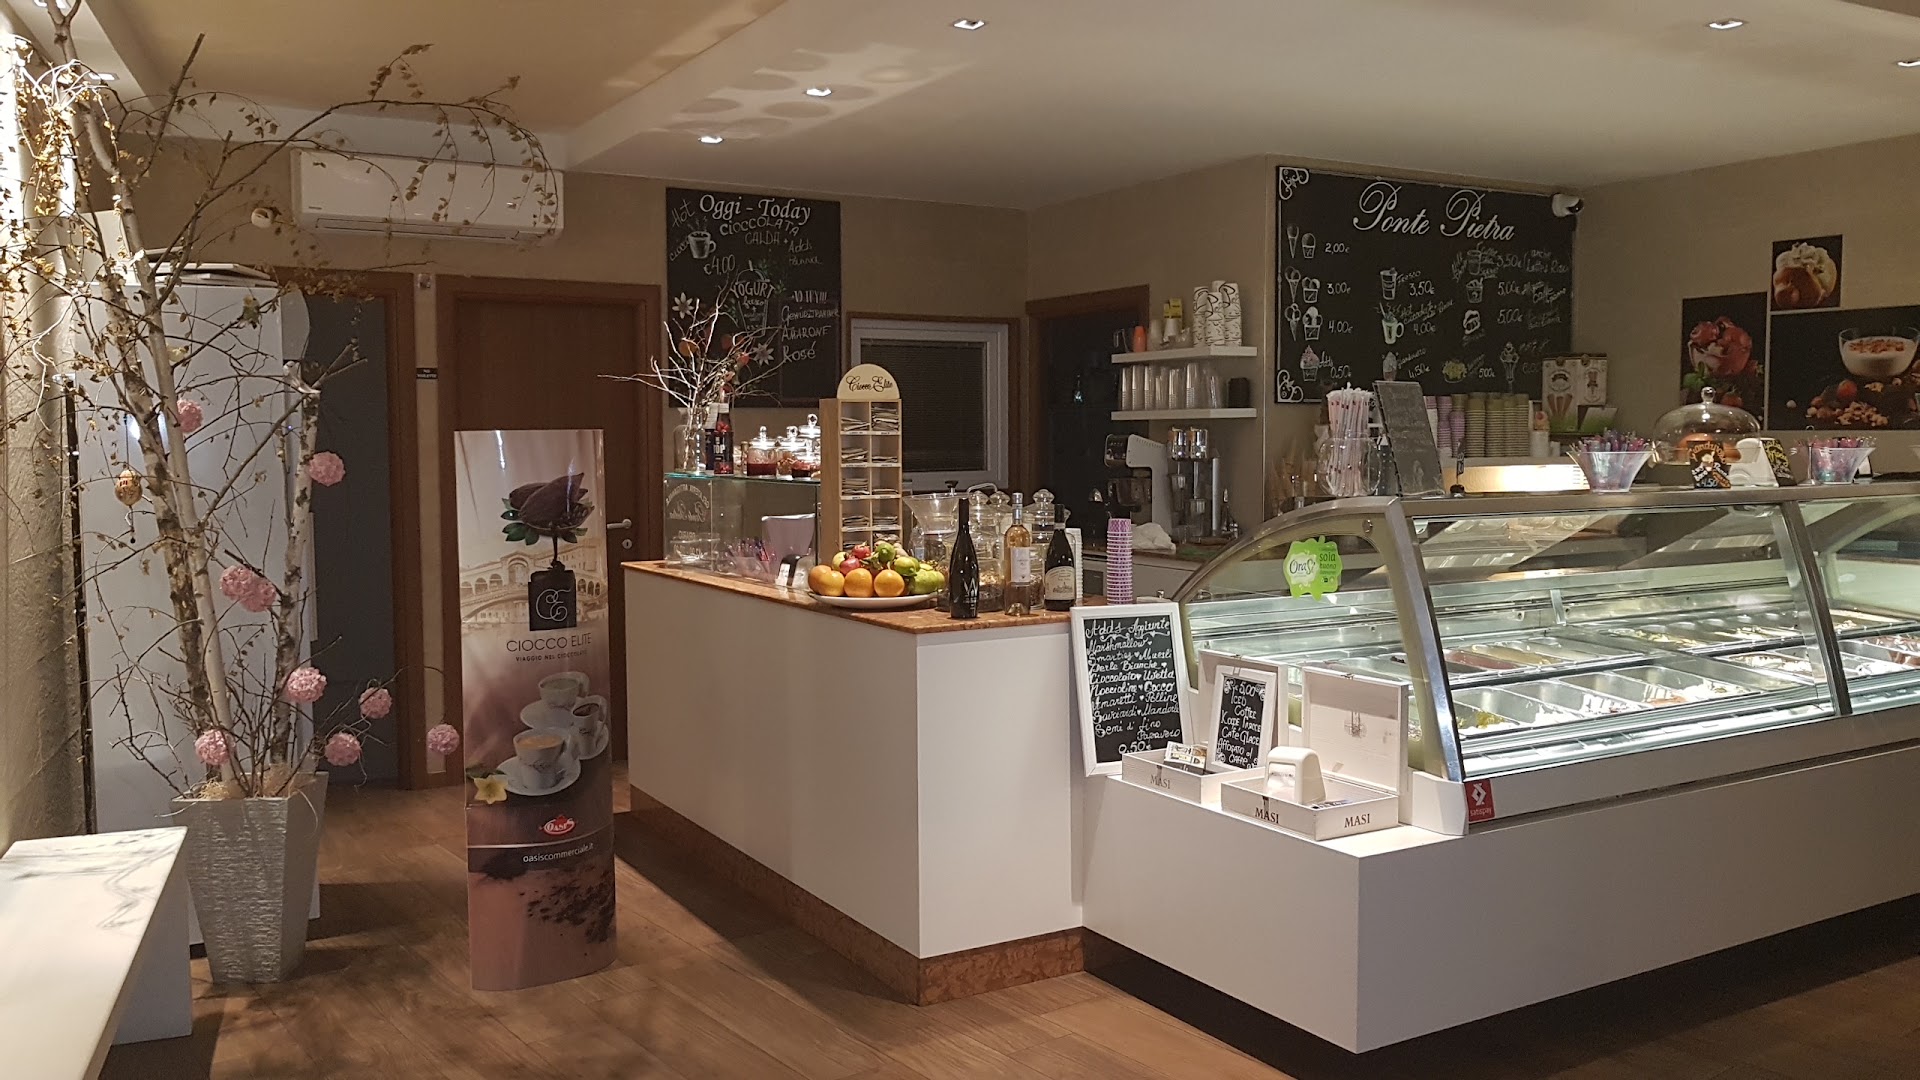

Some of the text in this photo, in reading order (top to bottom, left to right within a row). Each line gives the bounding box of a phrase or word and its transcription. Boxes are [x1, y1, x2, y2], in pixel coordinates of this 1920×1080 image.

[700, 194, 742, 220] Oggi
[758, 198, 811, 225] Today
[1353, 181, 1515, 241] Ponte Pietra
[729, 281, 776, 299] YOGURT
[1085, 620, 1126, 638] Adds
[506, 632, 592, 652] CIOCCO ELITE
[1087, 637, 1148, 655] Marshmallow
[1144, 681, 1175, 693] Cocco
[1095, 720, 1123, 737] Semi
[1150, 774, 1171, 790] MASI
[1254, 807, 1280, 824] MASI
[1344, 813, 1371, 828] MASI
[522, 842, 594, 863] oasiscommerciale.it
